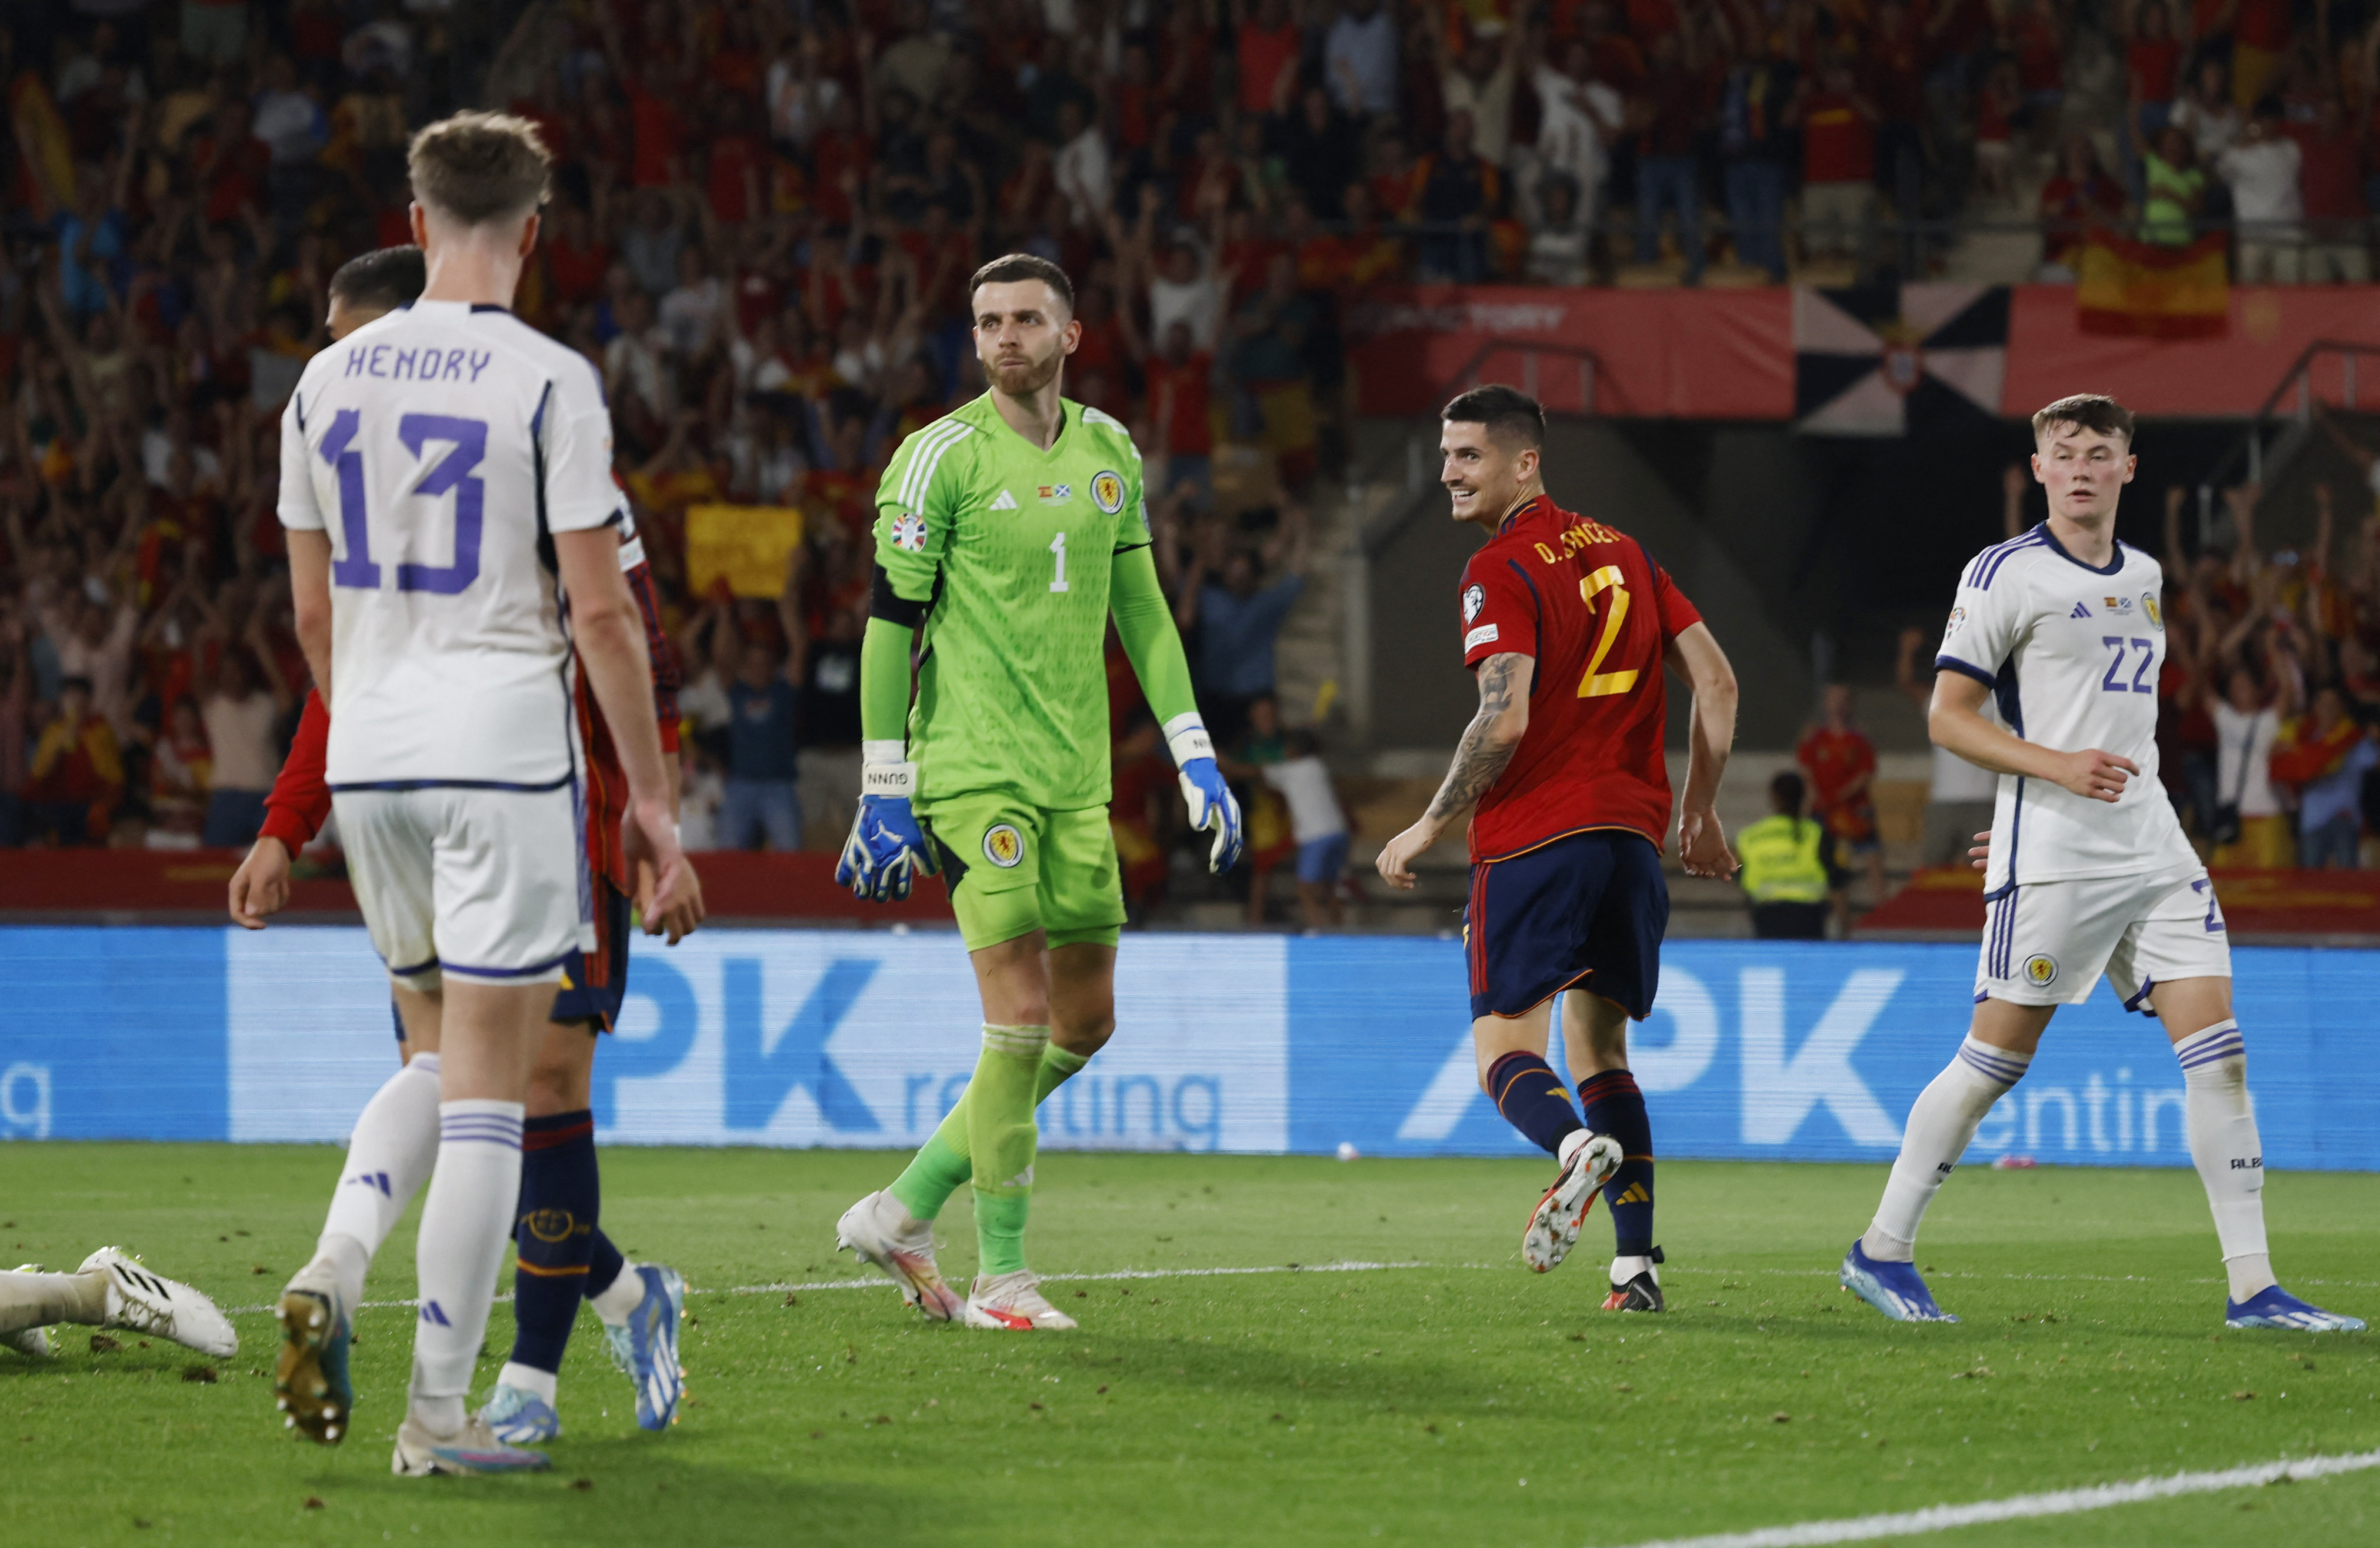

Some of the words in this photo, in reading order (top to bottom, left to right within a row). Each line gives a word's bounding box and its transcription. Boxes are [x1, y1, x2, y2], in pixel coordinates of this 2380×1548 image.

[345, 344, 491, 383] HENDRY
[319, 409, 488, 594] 13
[1048, 532, 1069, 593] 1
[1576, 565, 1639, 699] 2
[2102, 636, 2154, 694] 22
[868, 772, 908, 785] GUNN
